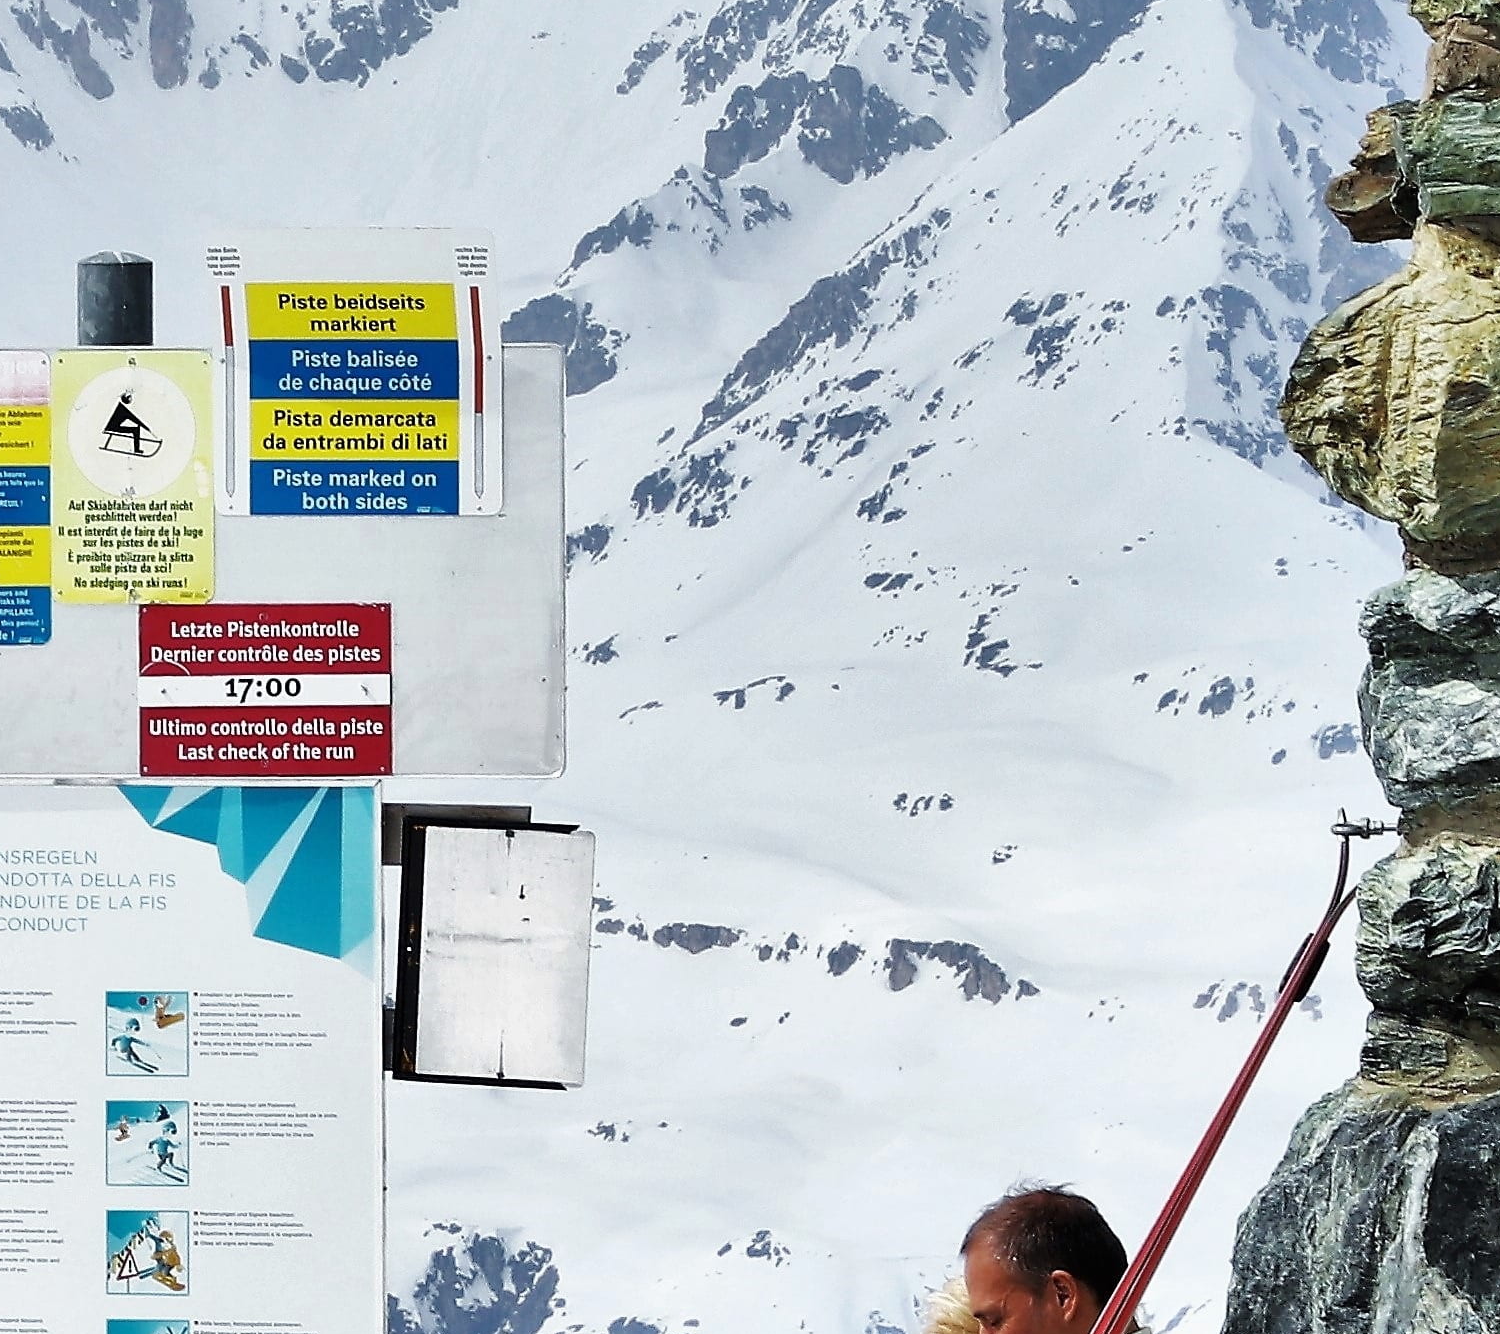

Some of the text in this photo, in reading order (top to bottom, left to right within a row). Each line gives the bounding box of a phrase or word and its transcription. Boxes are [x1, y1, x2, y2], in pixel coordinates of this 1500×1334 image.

[278, 294, 425, 310] Piste beidseits
[311, 316, 396, 332] markiert
[292, 350, 418, 367] Piste balisée
[279, 373, 432, 394] de chaque côté
[275, 410, 436, 427] Pista demarcata
[264, 433, 447, 450] da entrambi di lati
[274, 469, 436, 487] Piste marked on
[69, 500, 193, 511] Auf Skiabfahrten darf nicht
[303, 492, 348, 509] both
[356, 493, 407, 509] sides
[85, 511, 177, 524] geschlittelt werden!
[59, 526, 203, 539] Il est interdit de faire de la luge
[100, 538, 114, 547] les
[117, 538, 144, 549] pistes
[148, 538, 158, 547] de
[162, 538, 178, 547] ski!
[77, 552, 112, 565] proibito
[159, 552, 167, 563] la
[169, 552, 194, 563] slitta
[90, 563, 112, 573] sulle
[141, 563, 151, 573] da
[155, 563, 172, 573] sci!
[74, 577, 187, 591] No sledging on ski runs!
[172, 620, 359, 637] Letzte Pistenkontrolle
[151, 645, 380, 665] Dernier contrôle des pistes
[225, 678, 301, 703] 17:00
[150, 718, 383, 739] Ultimo controllo della piste
[179, 743, 354, 761] Last check of the run
[82, 873, 142, 887] DELLA
[150, 874, 176, 887] FIS
[77, 895, 100, 909] DE
[109, 896, 132, 909] LA
[140, 896, 166, 910] FIS
